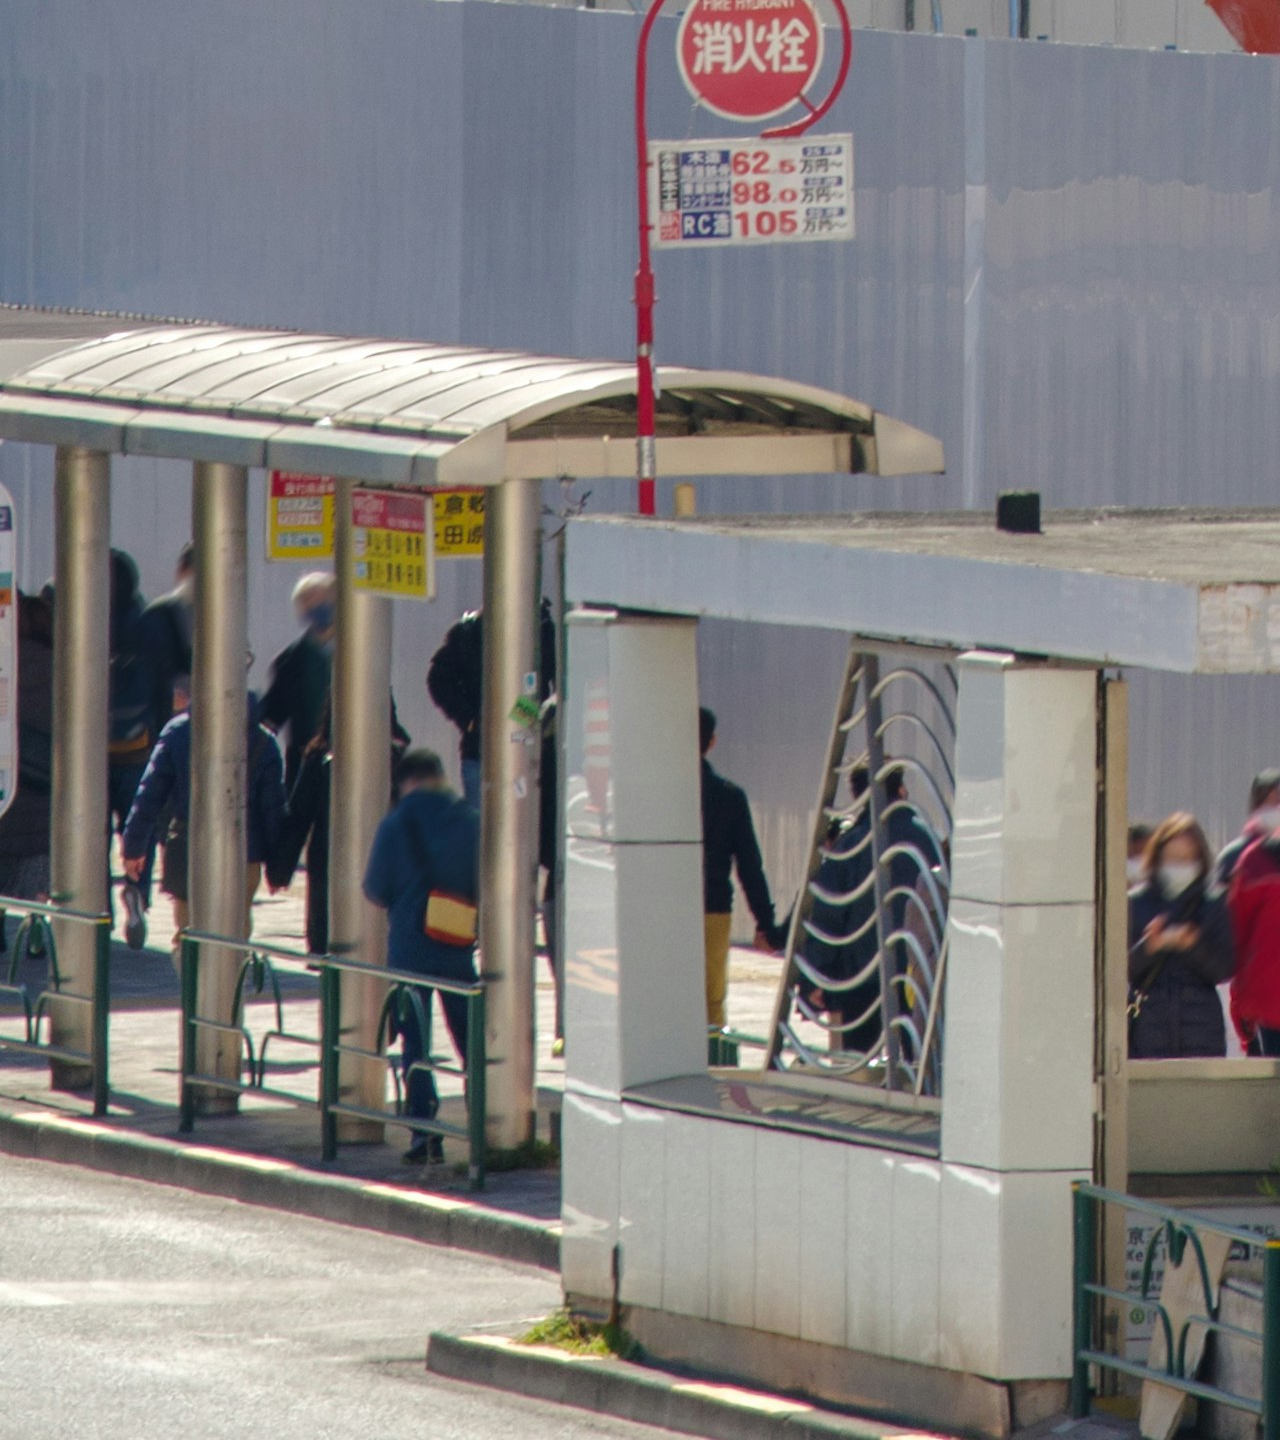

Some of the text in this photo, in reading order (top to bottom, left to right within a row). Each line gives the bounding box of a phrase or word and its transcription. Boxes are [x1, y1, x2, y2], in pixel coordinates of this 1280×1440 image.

[692, 17, 810, 75] 消火栓
[736, 210, 798, 237] 105
